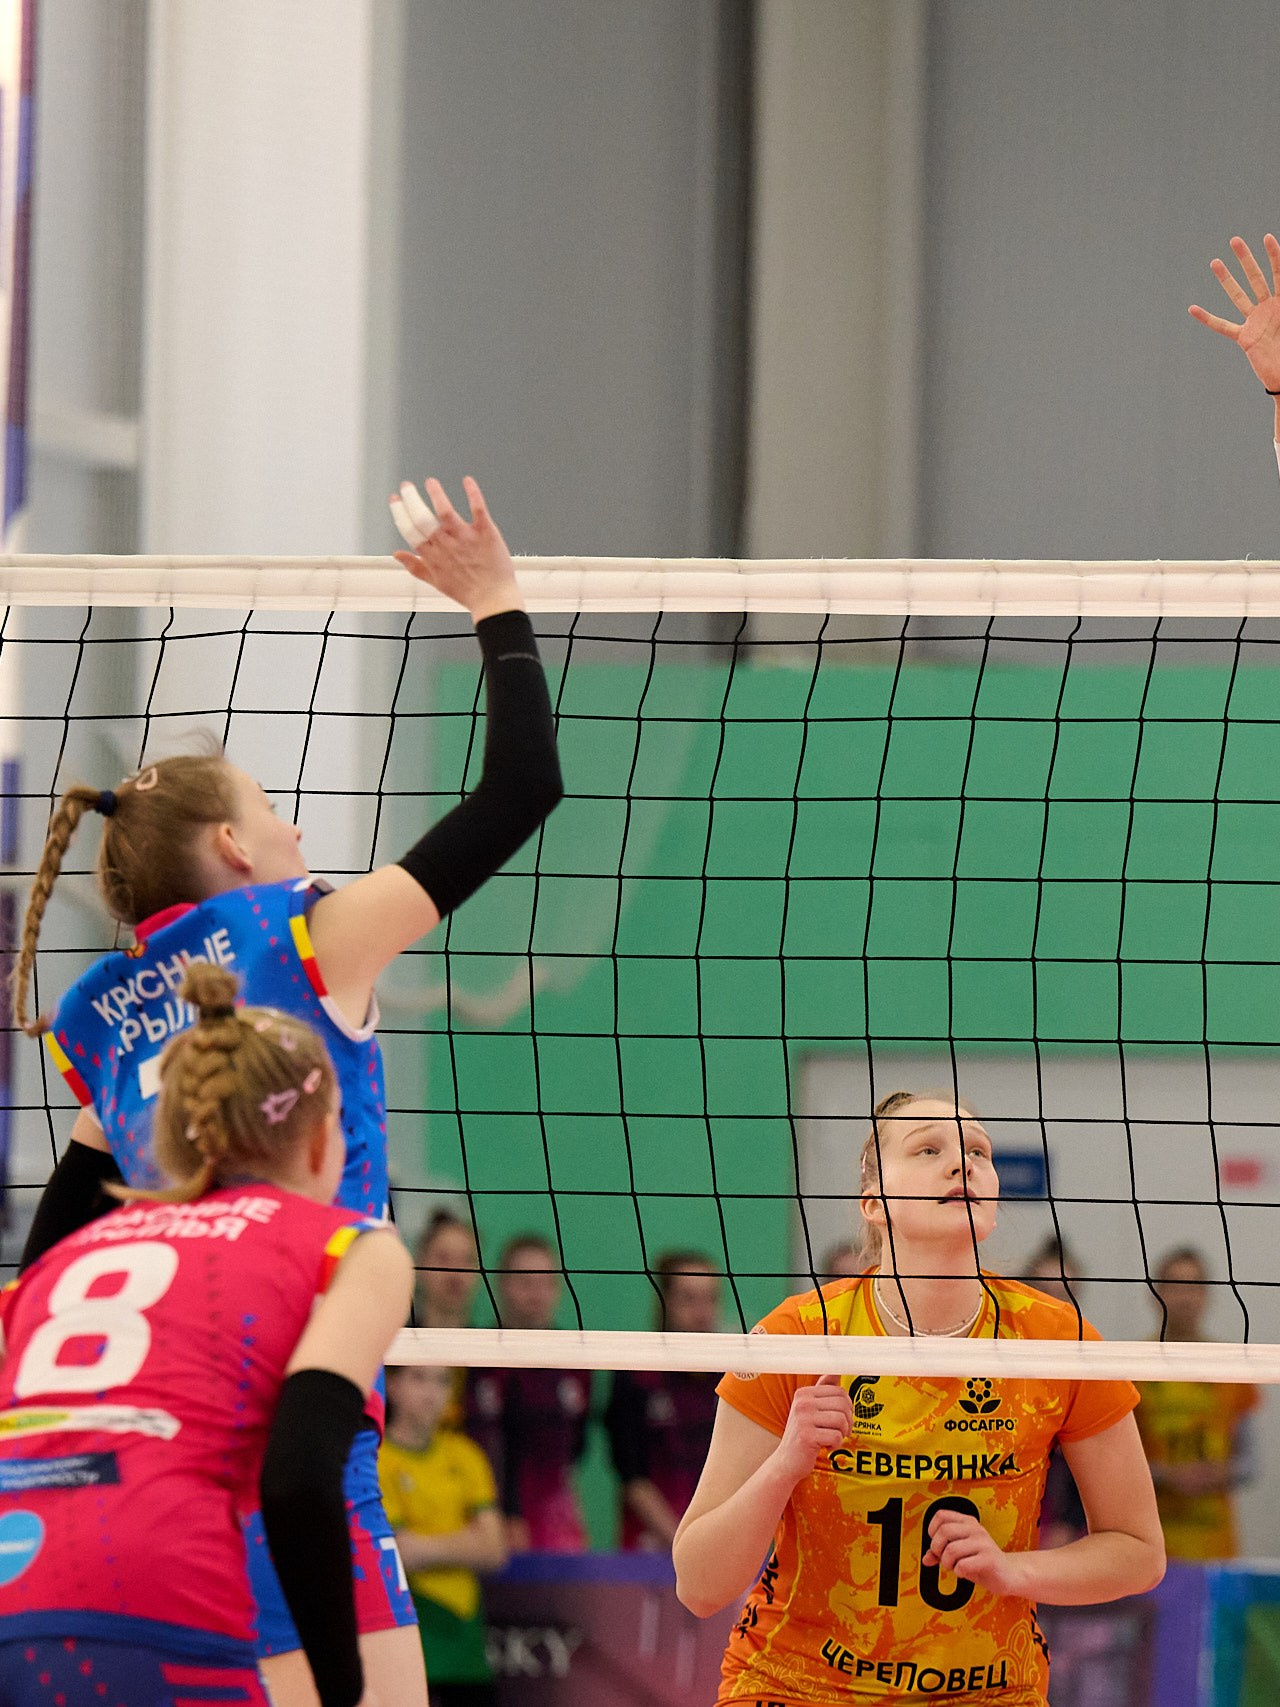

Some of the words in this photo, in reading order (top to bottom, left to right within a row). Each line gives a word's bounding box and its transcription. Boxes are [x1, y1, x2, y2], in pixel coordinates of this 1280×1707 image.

[15, 1241, 179, 1397] 8
[853, 1420, 882, 1431] ЕРЯНКА
[943, 1418, 1016, 1432] ФОСАГРО
[829, 1448, 1021, 1481] СЕВЕРЯНКА
[820, 1637, 1008, 1694] ЧЕРЕПОВЕЦ
